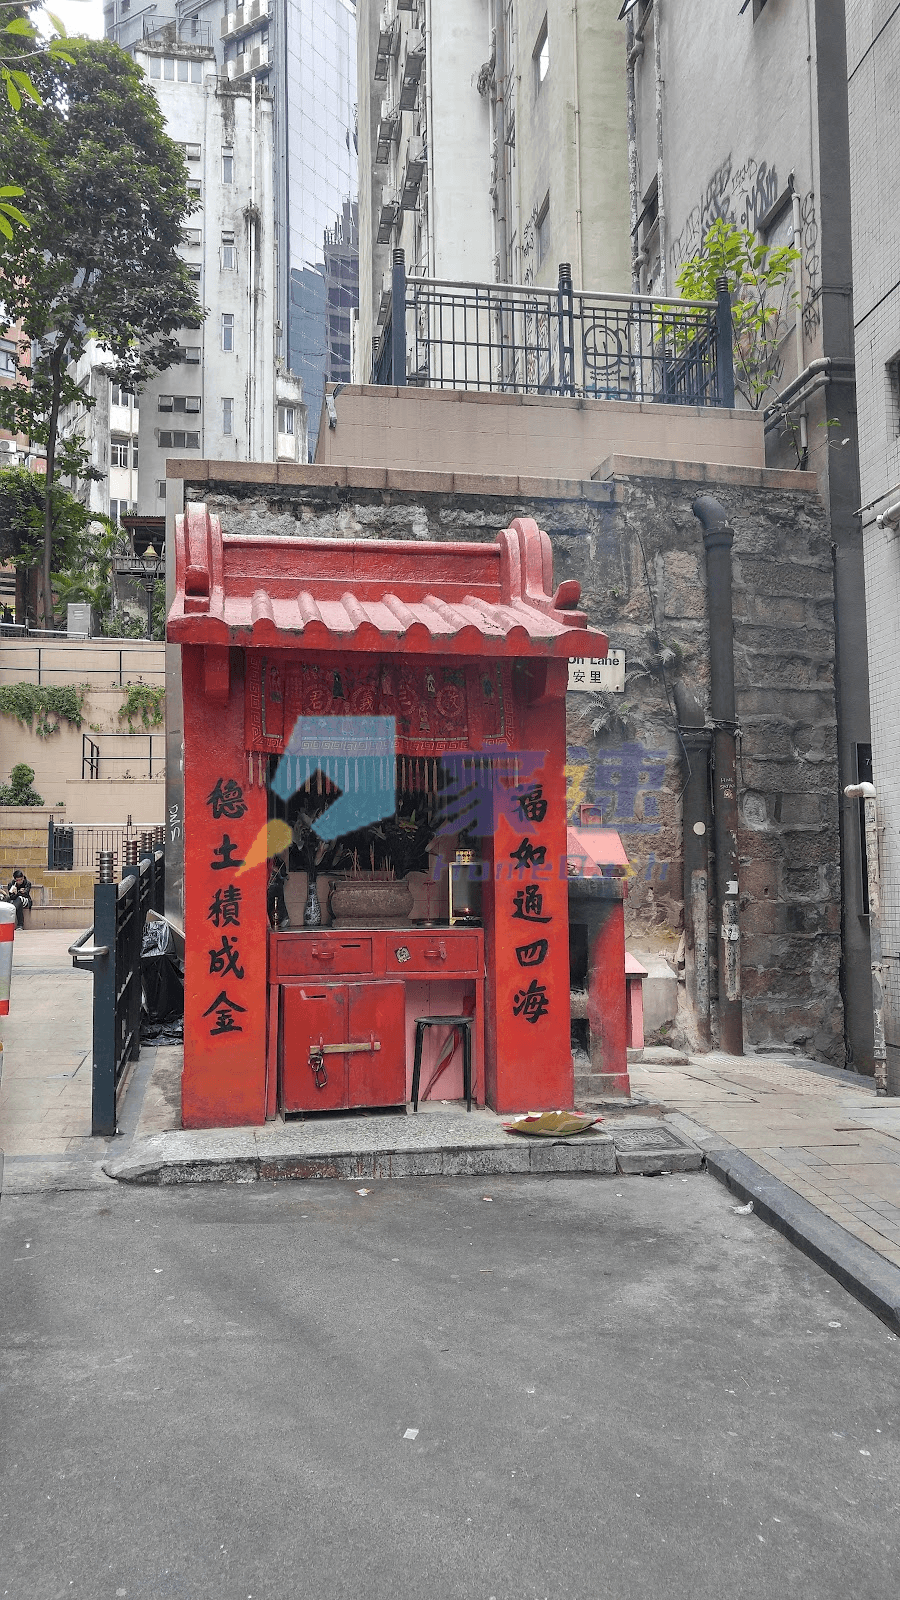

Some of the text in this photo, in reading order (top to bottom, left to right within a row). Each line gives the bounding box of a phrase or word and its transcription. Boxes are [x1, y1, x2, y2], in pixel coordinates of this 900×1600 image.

[590, 657, 620, 666] Lane
[573, 669, 601, 684] 安里
[510, 783, 553, 1024] 福如通四海
